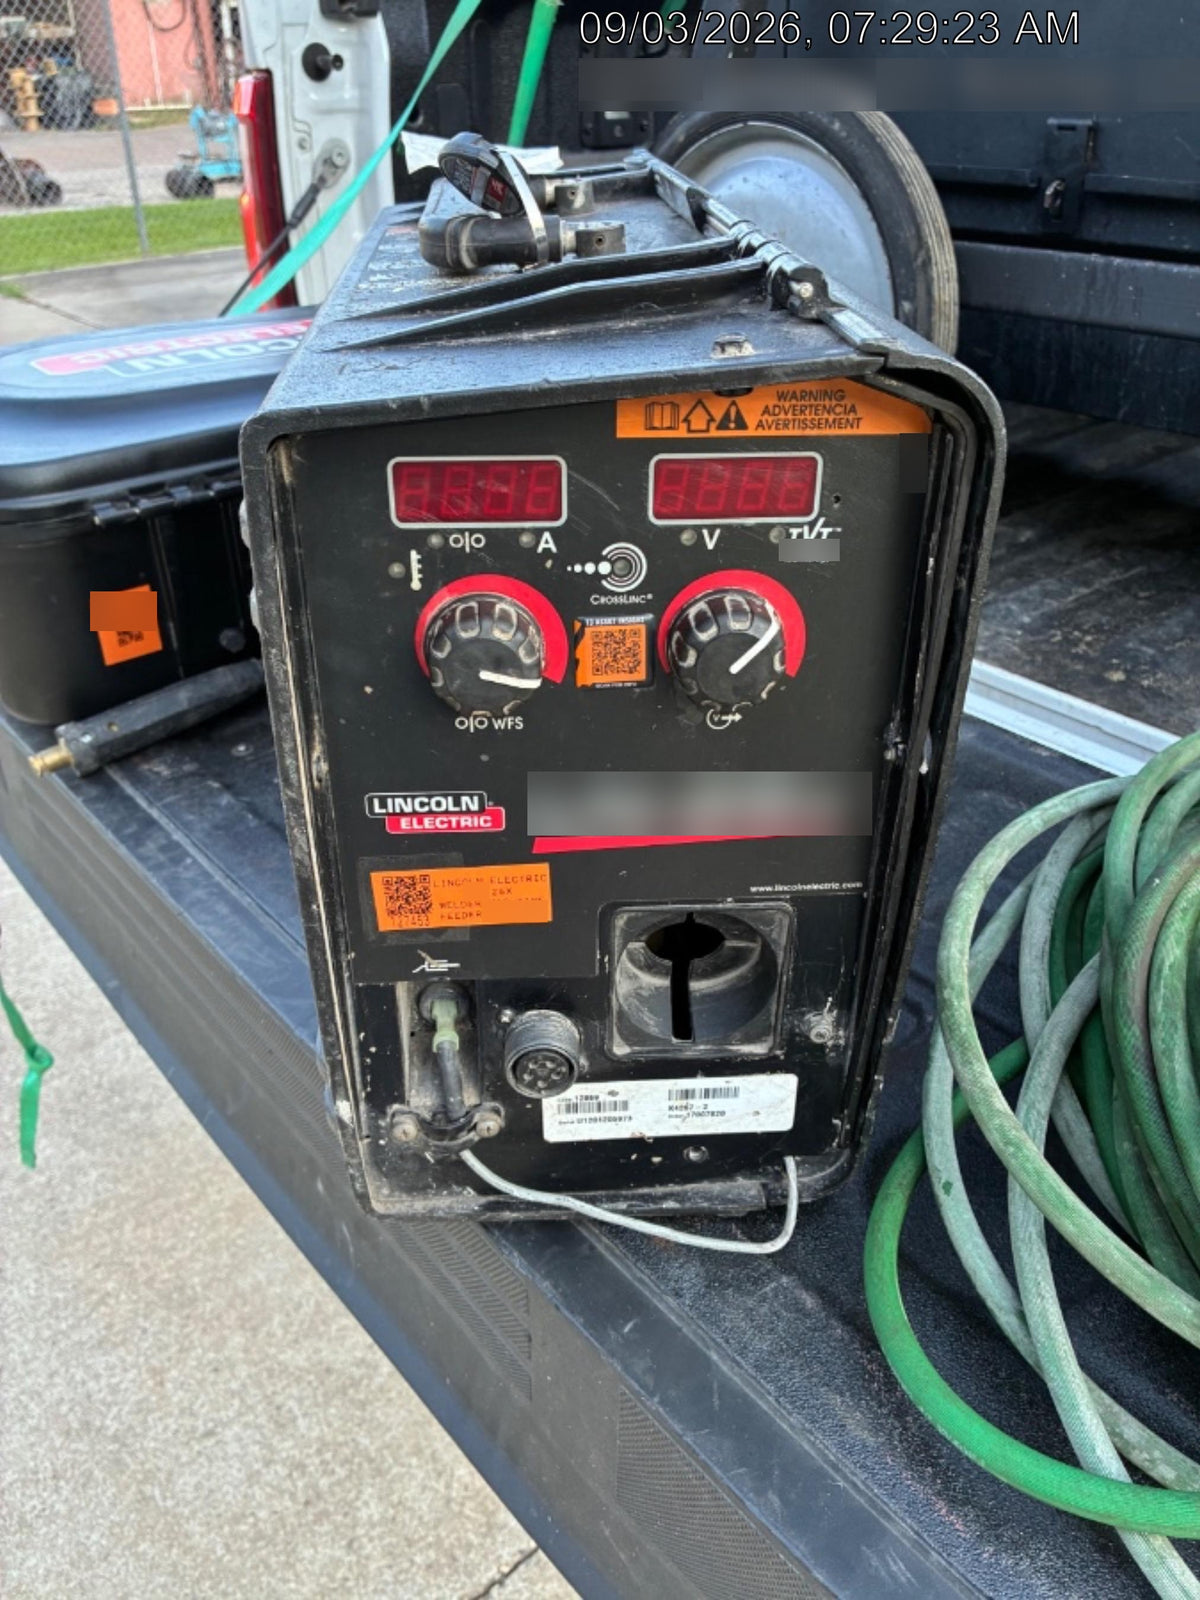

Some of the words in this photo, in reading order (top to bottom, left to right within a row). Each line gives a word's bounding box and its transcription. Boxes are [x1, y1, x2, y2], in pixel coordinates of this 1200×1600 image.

[128, 336, 299, 372] COLN
[776, 389, 846, 402] WARNING
[760, 402, 858, 417] ADVERTENCIA
[755, 416, 863, 431] AVERTISSEMENT
[536, 531, 558, 554] A
[702, 529, 721, 550] V
[492, 716, 524, 730] WFS
[372, 795, 480, 813] LINCOLN
[400, 816, 492, 830] ELECTRIC
[750, 882, 863, 892] www.lincolnelectric.com
